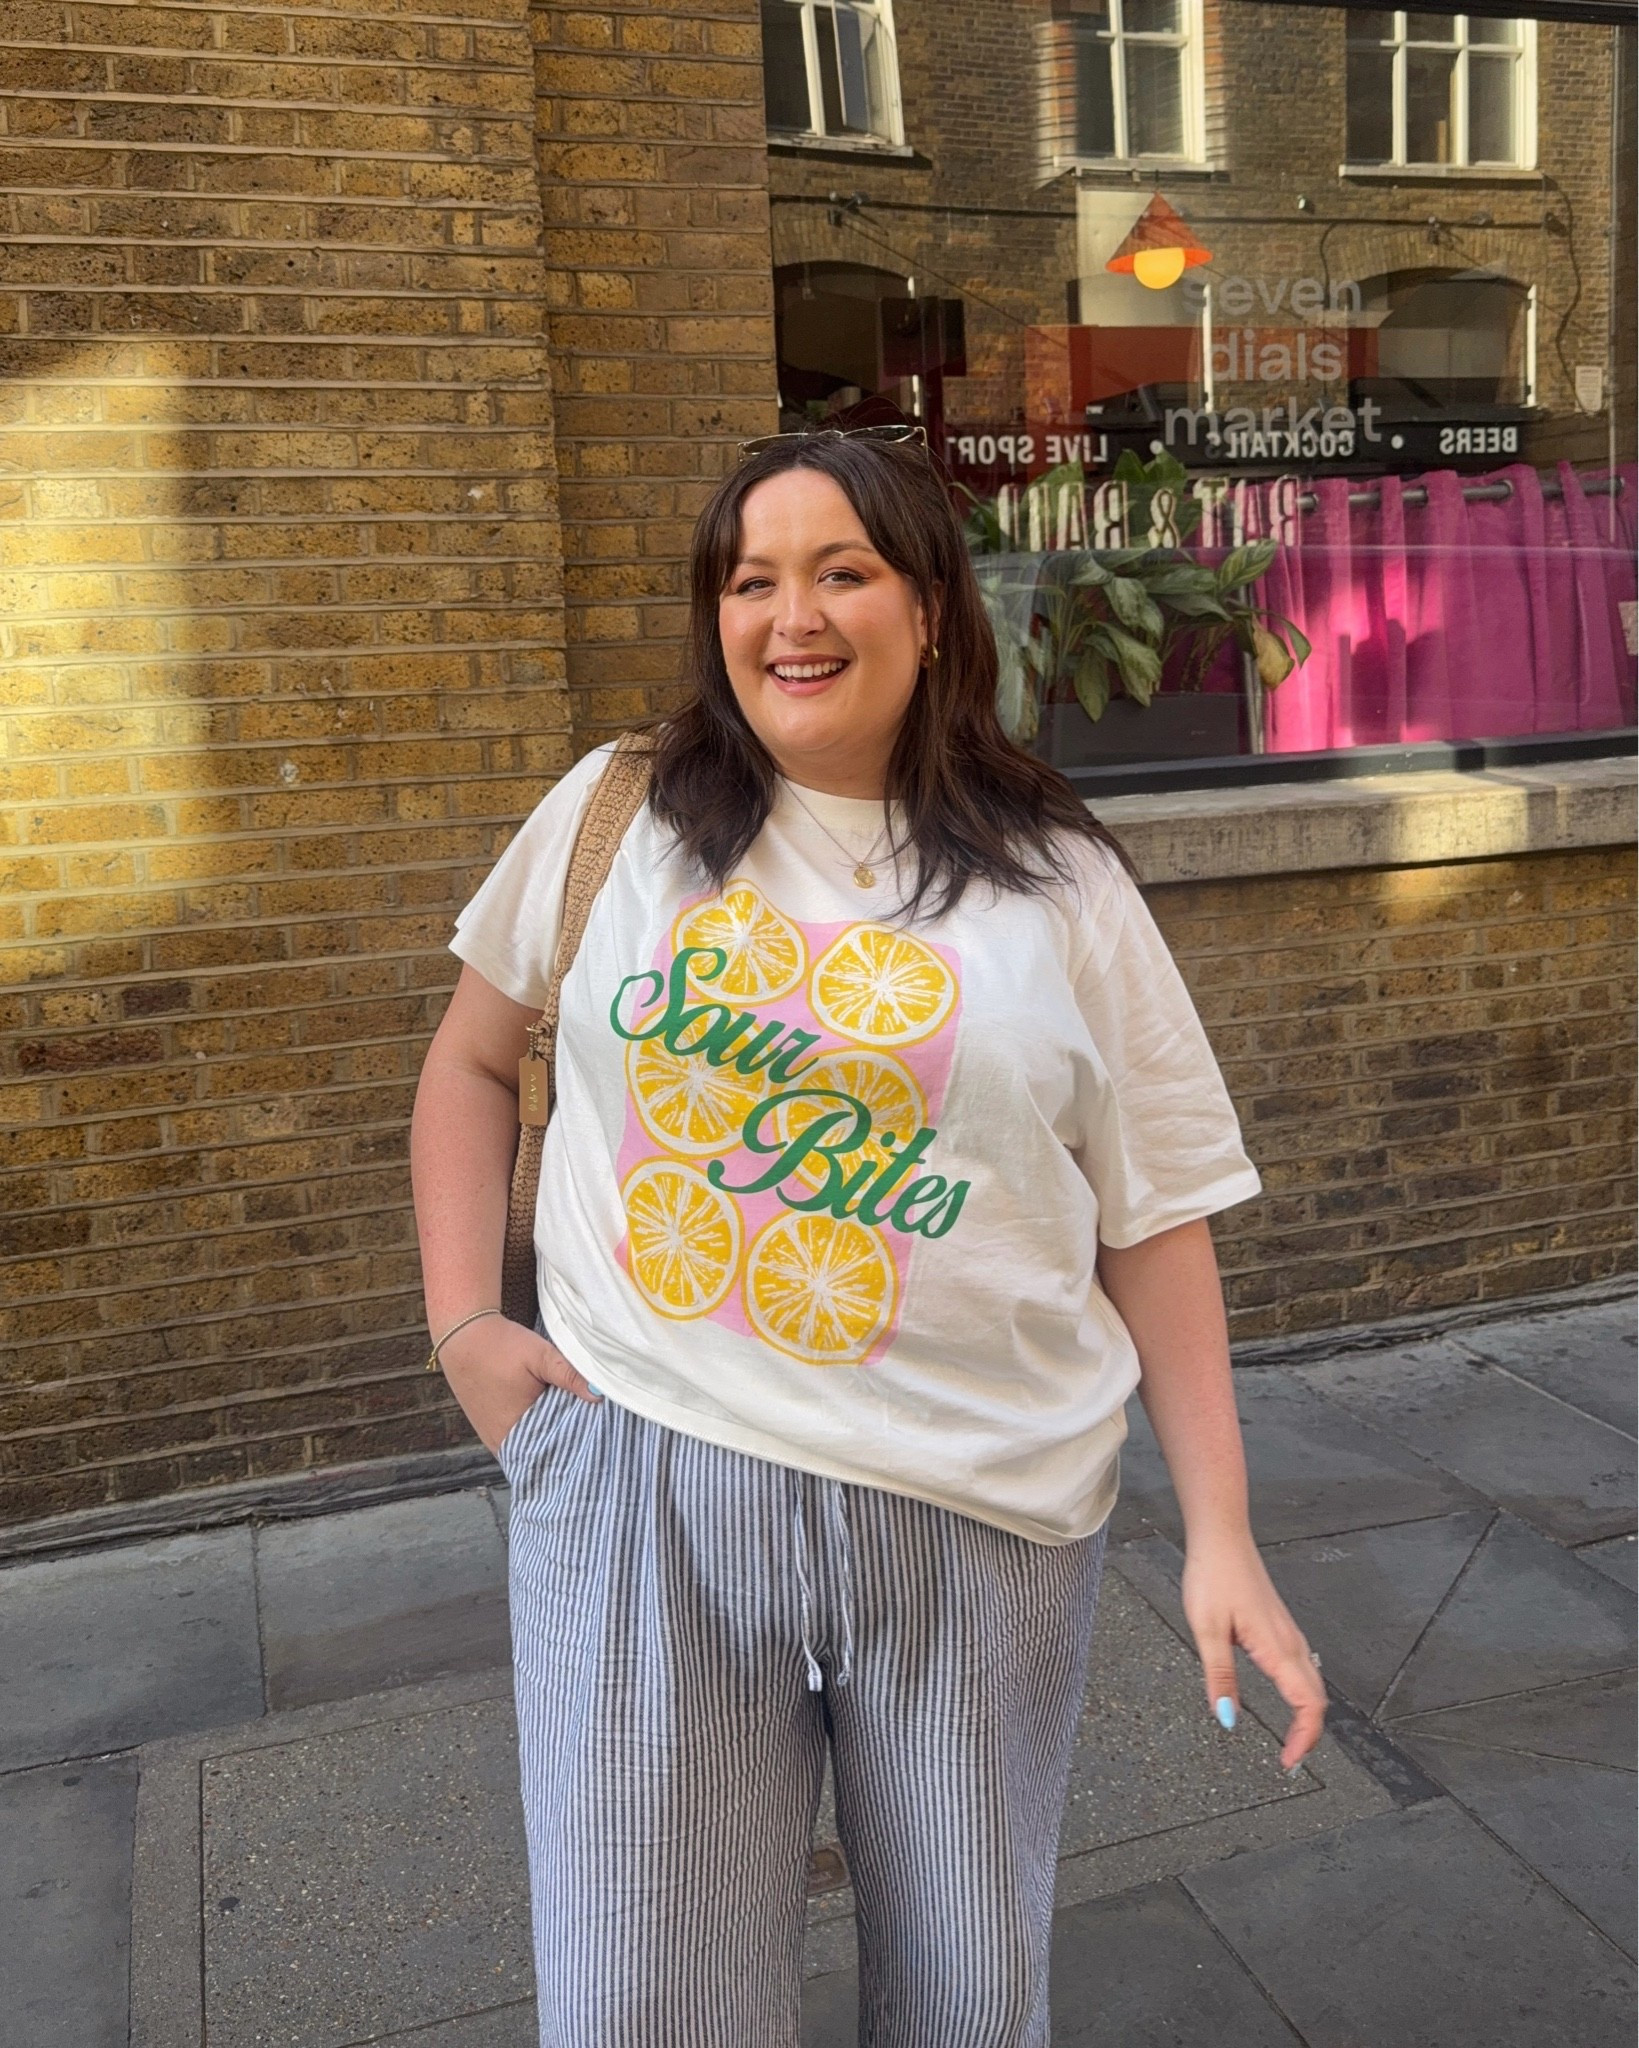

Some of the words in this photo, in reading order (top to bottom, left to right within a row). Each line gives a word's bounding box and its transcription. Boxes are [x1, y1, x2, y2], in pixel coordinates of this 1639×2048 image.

[1182, 275, 1361, 316] seven
[1210, 329, 1342, 381] dials
[1165, 397, 1382, 445] market
[610, 947, 821, 1084] Sour
[707, 1089, 972, 1239] Bites
